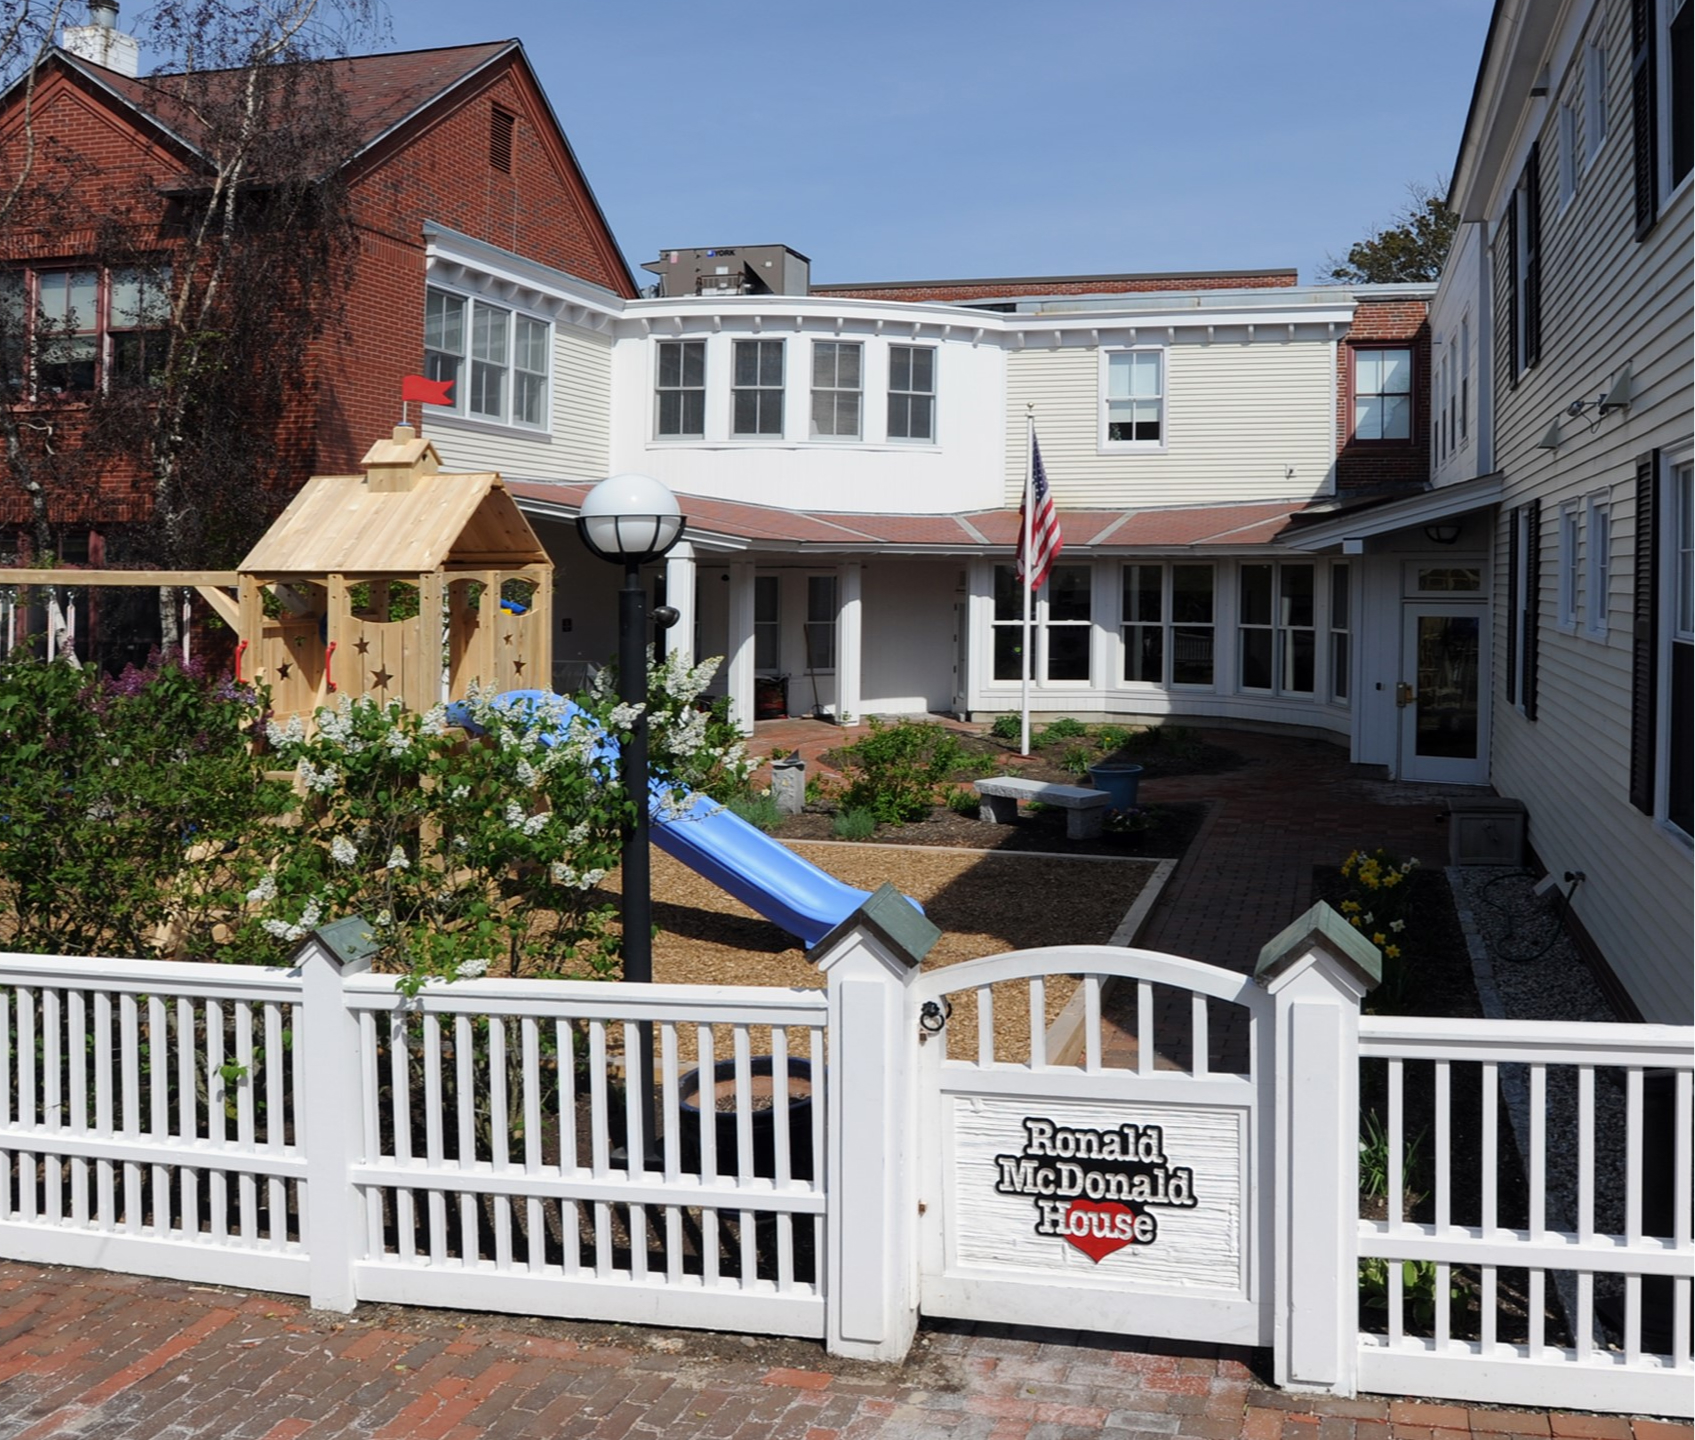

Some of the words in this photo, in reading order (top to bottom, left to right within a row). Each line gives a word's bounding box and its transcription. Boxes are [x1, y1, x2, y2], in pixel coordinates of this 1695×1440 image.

[715, 249, 736, 257] YORK
[1025, 1119, 1165, 1164] Ronald
[997, 1156, 1195, 1205] McDonald
[1037, 1199, 1154, 1242] House
